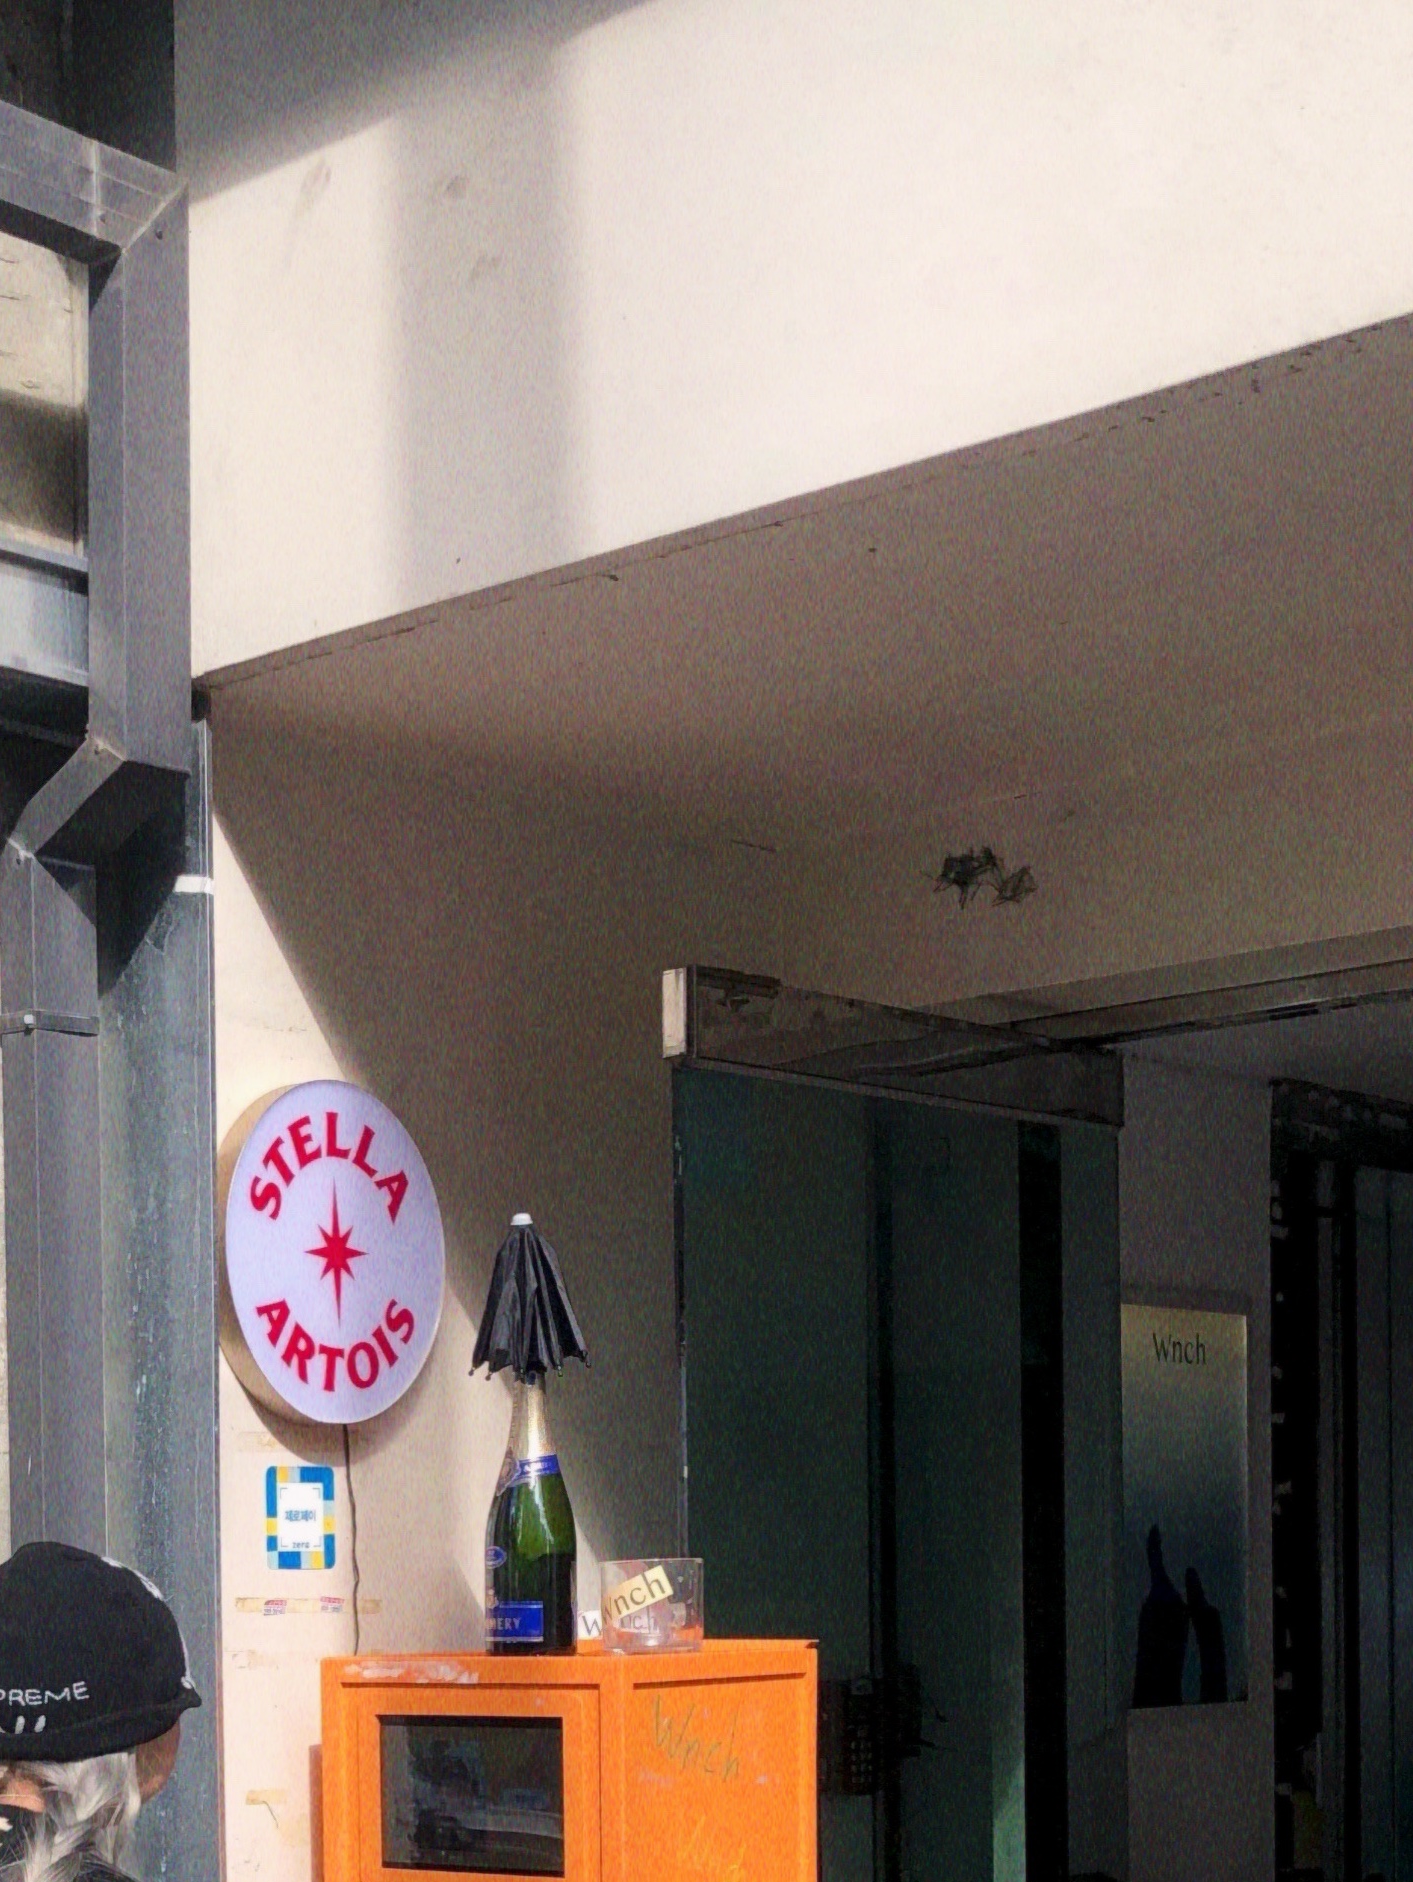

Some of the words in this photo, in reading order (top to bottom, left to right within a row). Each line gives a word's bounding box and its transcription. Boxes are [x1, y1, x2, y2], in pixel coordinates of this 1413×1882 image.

[250, 1112, 410, 1225] STELLA
[256, 1299, 415, 1392] ARTOIS
[1152, 1332, 1207, 1366] Wnch
